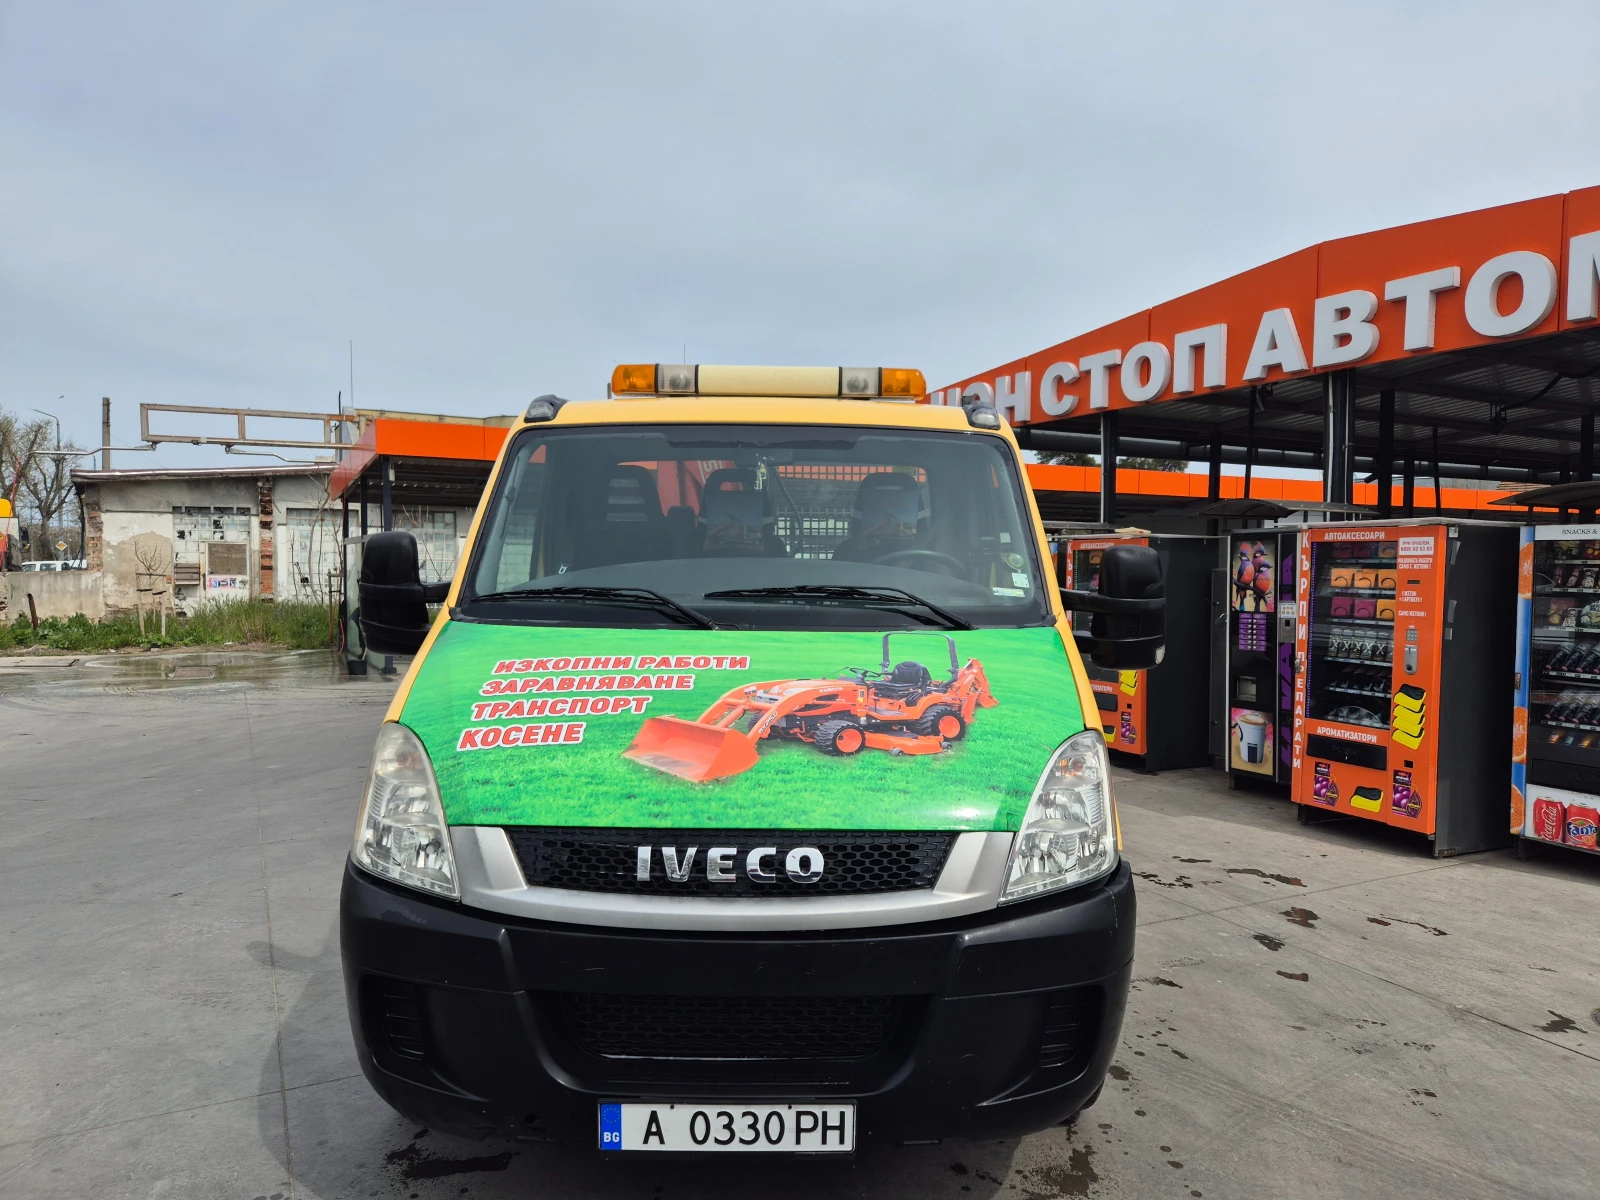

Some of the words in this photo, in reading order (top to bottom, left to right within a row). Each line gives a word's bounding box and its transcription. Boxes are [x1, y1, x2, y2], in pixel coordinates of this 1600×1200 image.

[1040, 322, 1228, 417] СТОП
[1324, 531, 1385, 540] АВТОАКСЕСОАРИ
[493, 656, 635, 674] ИЗКОПНИ
[636, 655, 750, 670] РАБОТИ
[481, 674, 695, 695] ЗАРАВНЯВАНЕ
[471, 696, 652, 721] ТРАНСПОРТ
[457, 722, 586, 750] КОСЕНЕ
[1317, 726, 1377, 743] АРОМАТИЗАТОРИ
[1566, 821, 1598, 836] Fanta
[636, 845, 825, 884] IVECO
[603, 1131, 620, 1143] BG
[642, 1110, 665, 1145] A
[689, 1110, 786, 1146] 0330
[795, 1110, 846, 1146] PH
